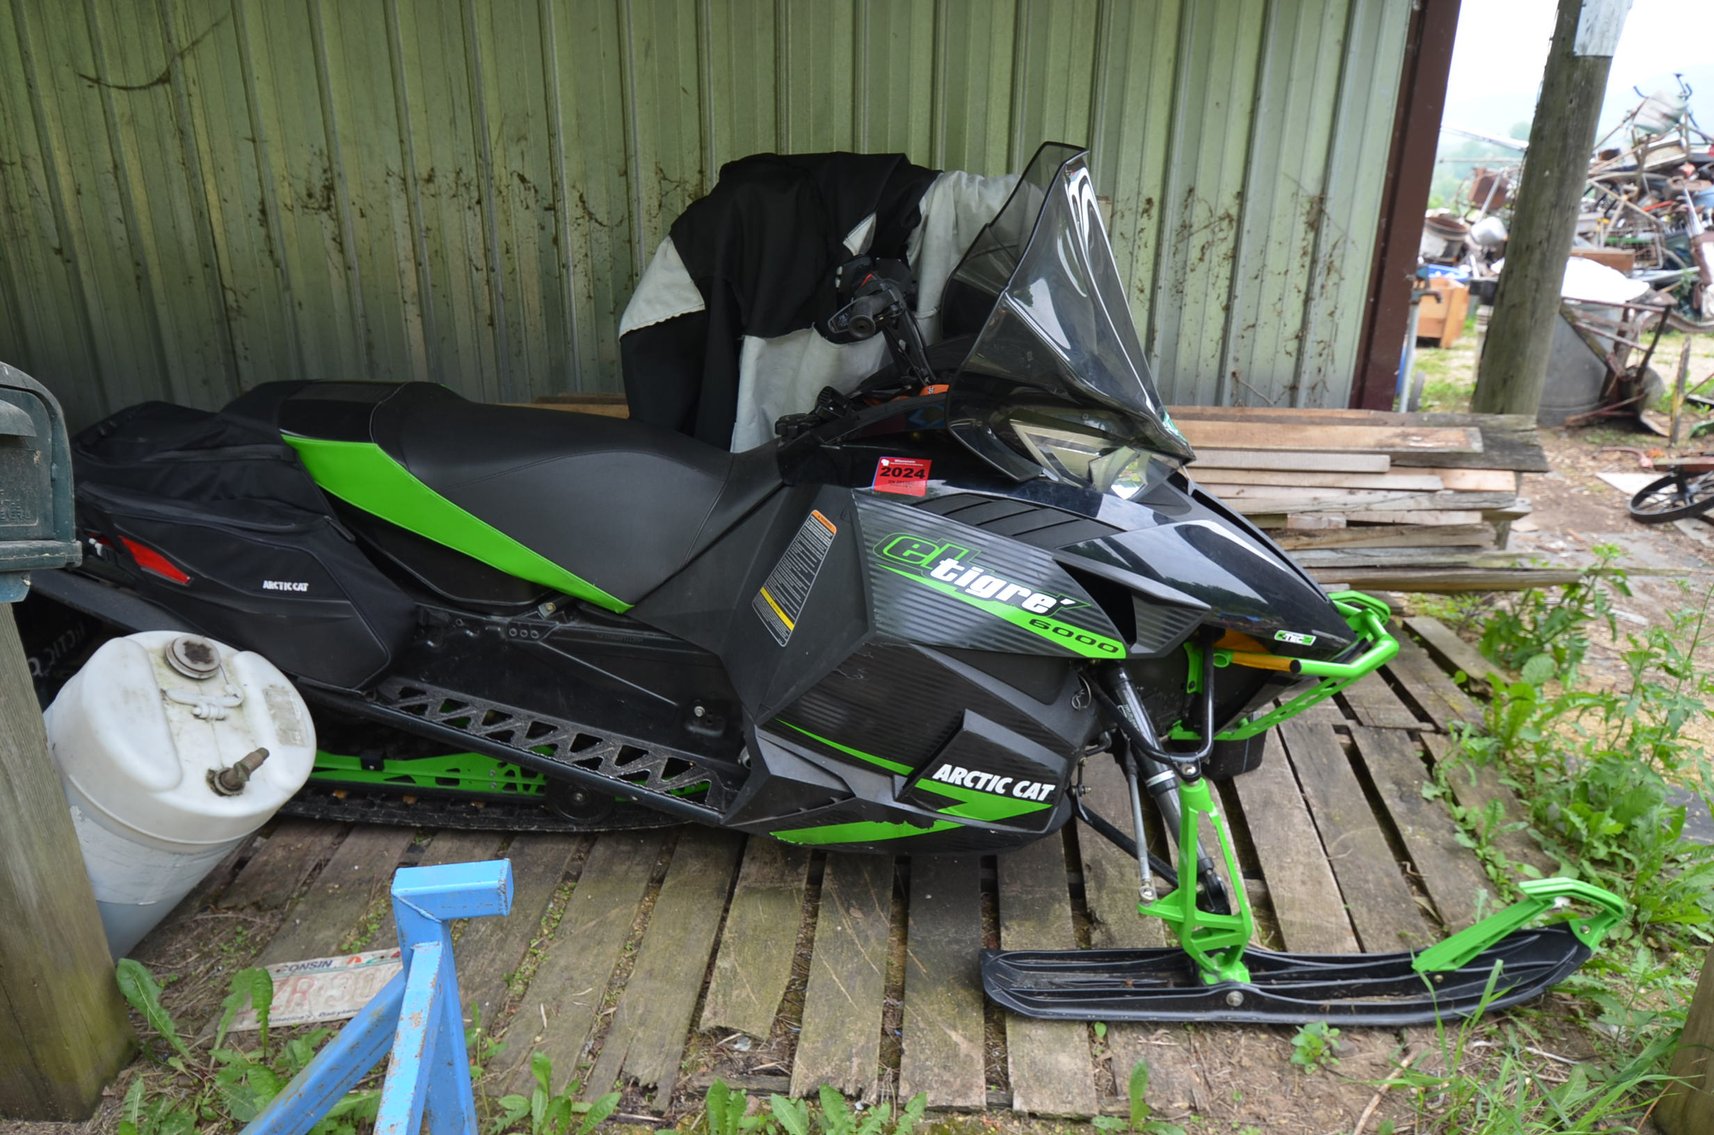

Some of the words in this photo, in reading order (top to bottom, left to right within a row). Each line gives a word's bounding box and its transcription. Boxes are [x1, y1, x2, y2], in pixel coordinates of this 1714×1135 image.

[880, 466, 926, 480] 2024
[263, 580, 292, 591] ARCTIC
[292, 582, 309, 592] CAT
[1028, 618, 1119, 653] 6000
[932, 763, 1013, 795] ARCTIC
[1012, 780, 1056, 801] CAT
